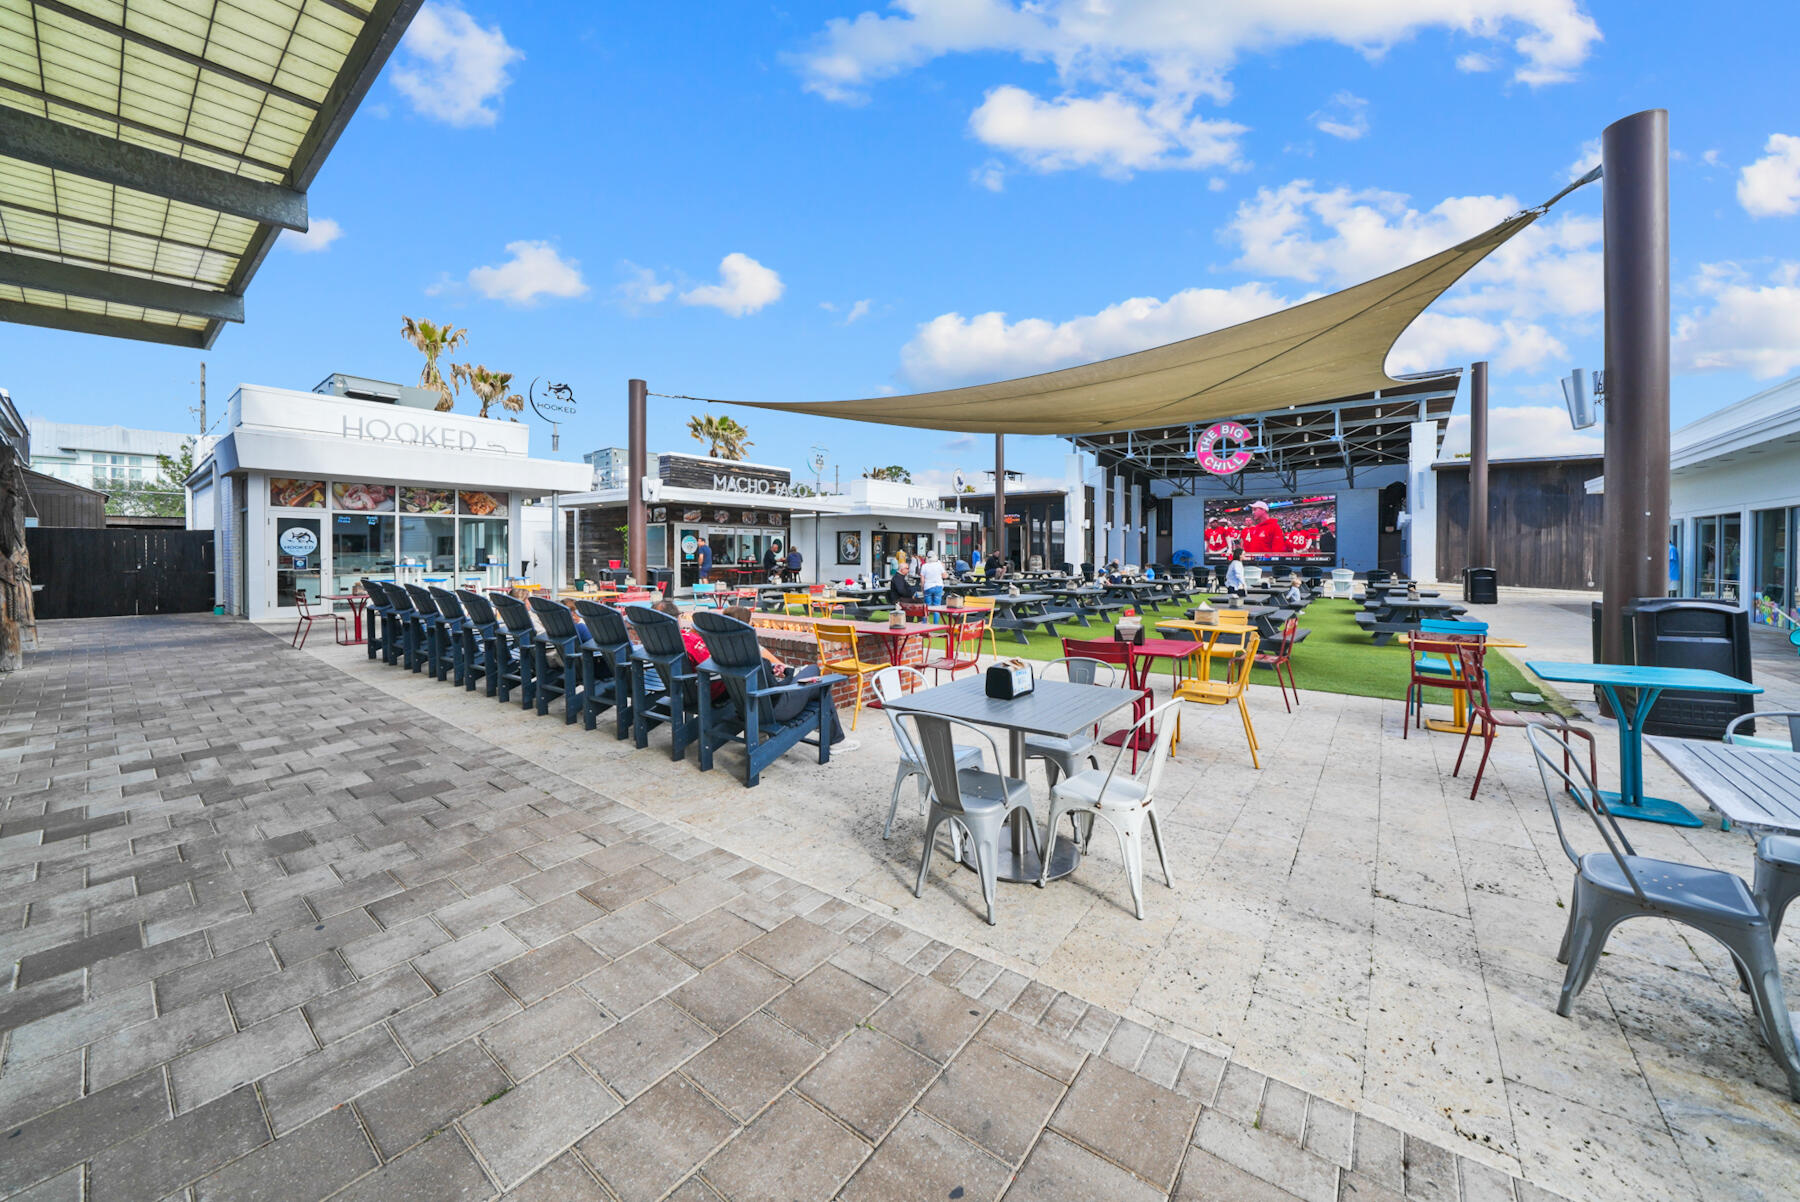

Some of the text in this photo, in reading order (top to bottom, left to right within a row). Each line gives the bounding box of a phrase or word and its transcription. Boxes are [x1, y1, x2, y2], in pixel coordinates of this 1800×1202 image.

[537, 402, 576, 414] HOOKED
[342, 415, 477, 451] HOOKED
[1200, 424, 1244, 453] THE BIG
[1204, 457, 1244, 471] CHILL
[713, 474, 808, 497] MACHO TACO
[907, 496, 924, 510] LIVE
[1209, 533, 1223, 547] 44
[1292, 534, 1306, 546] 28
